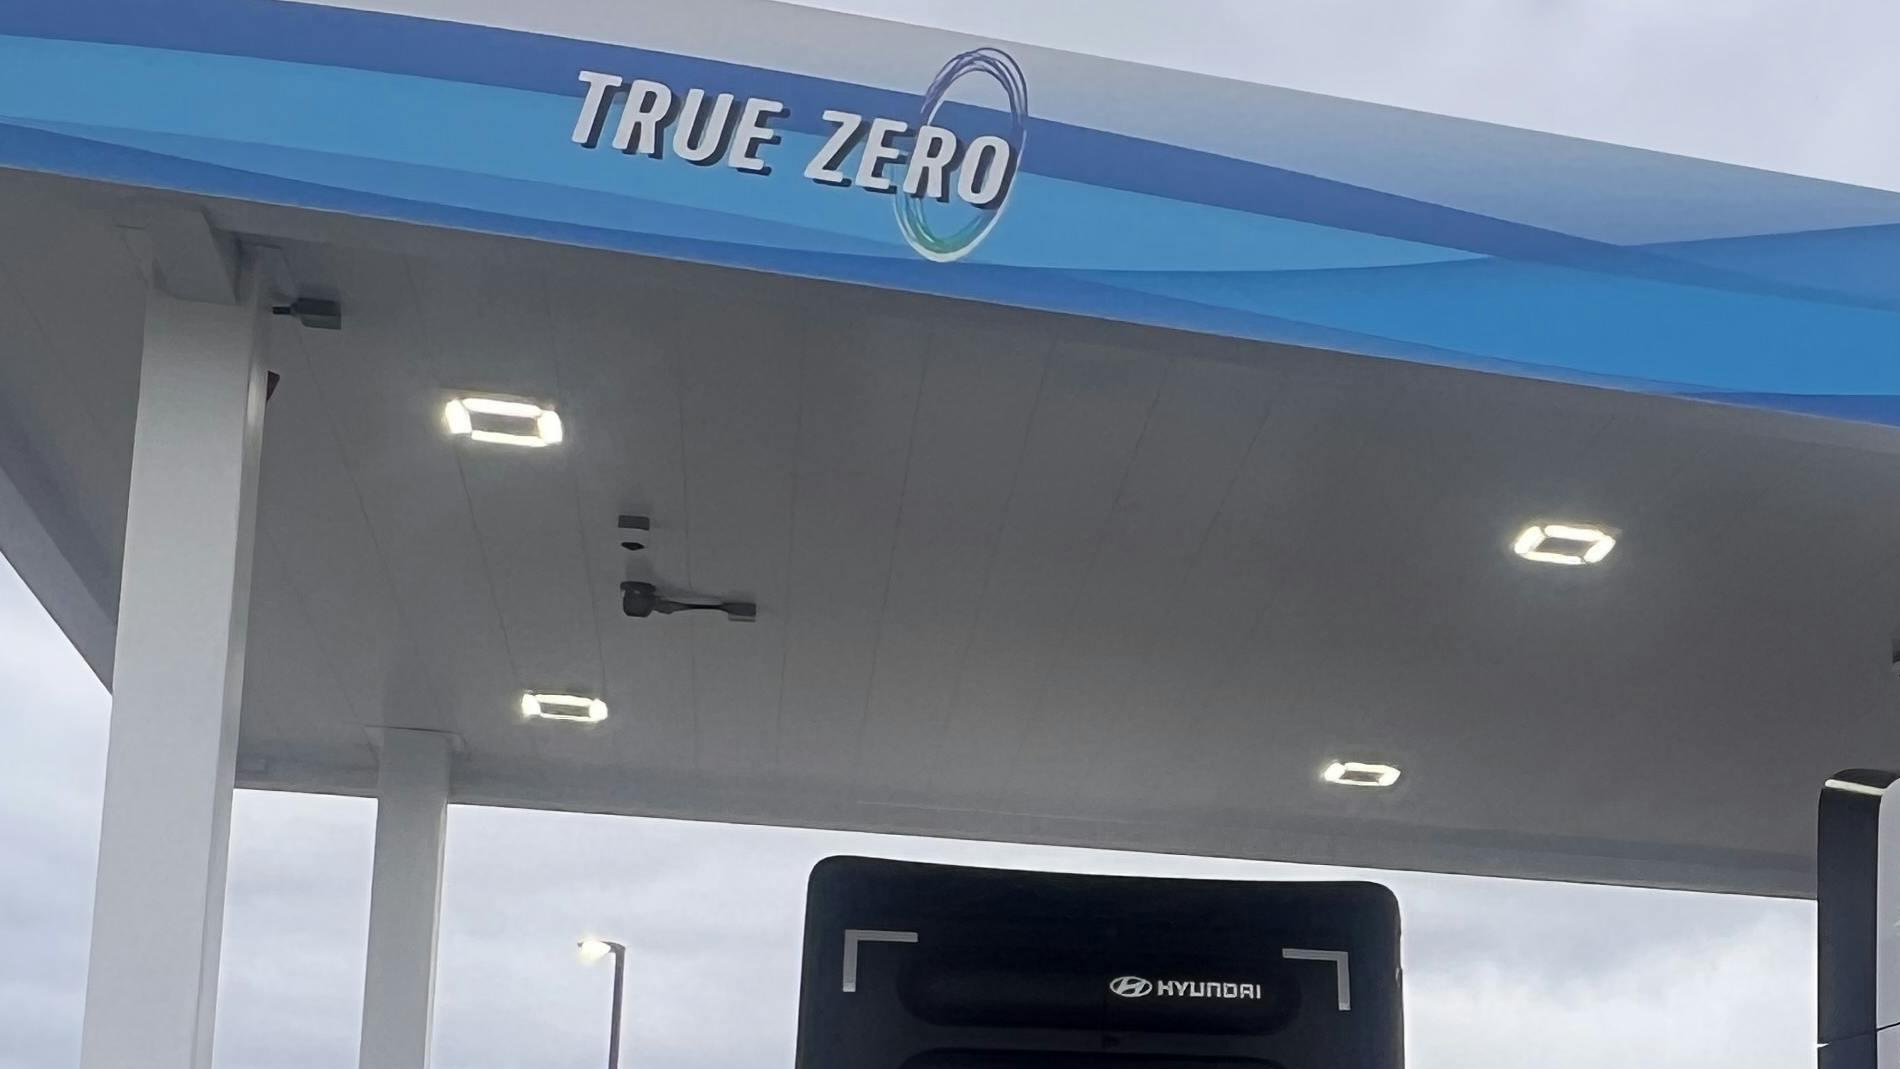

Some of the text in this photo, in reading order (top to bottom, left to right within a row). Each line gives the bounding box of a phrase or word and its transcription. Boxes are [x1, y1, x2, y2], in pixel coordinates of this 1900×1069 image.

[571, 70, 1013, 208] TRUE ZERO
[1157, 980, 1261, 999] HYUNDAI
